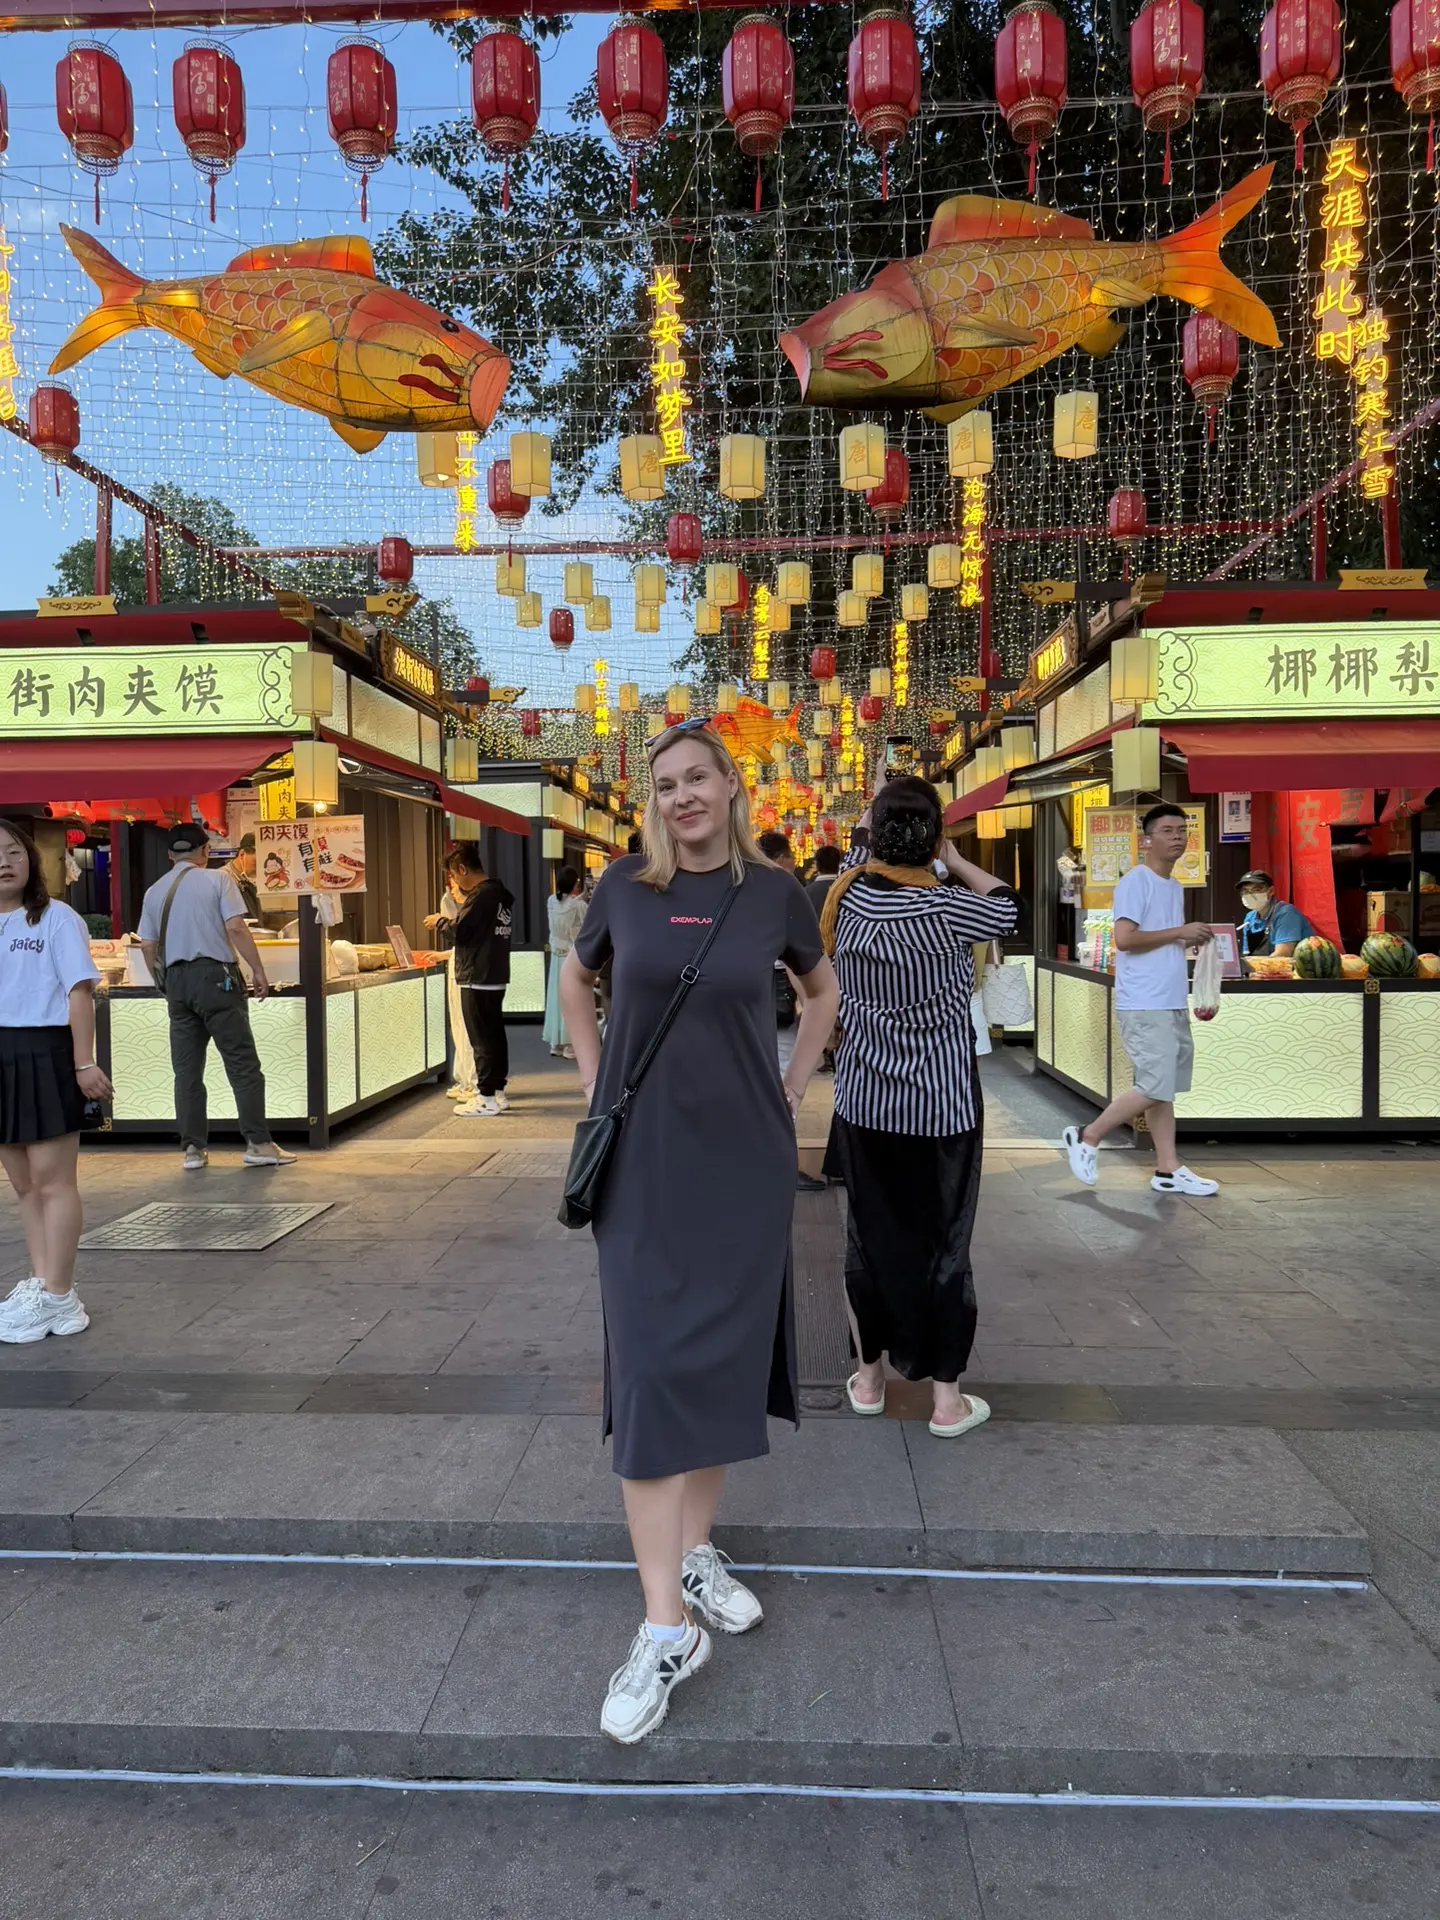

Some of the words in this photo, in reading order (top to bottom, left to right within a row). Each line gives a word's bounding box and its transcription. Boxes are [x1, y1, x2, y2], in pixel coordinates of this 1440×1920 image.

[1314, 146, 1368, 363] 天涯共此时
[647, 271, 693, 466] 长安如梦里
[1077, 406, 1095, 431] 唐
[1352, 315, 1395, 500] 独钓寒江雪
[640, 448, 657, 474] 唐
[848, 438, 866, 465] 唐
[955, 426, 973, 451] 唐
[959, 476, 986, 608] 沧海无惊浪
[8, 663, 224, 717] 街肉夹馍
[1264, 640, 1439, 698] 椰椰梨
[259, 823, 309, 841] 肉夹馍
[1296, 794, 1321, 850] 安
